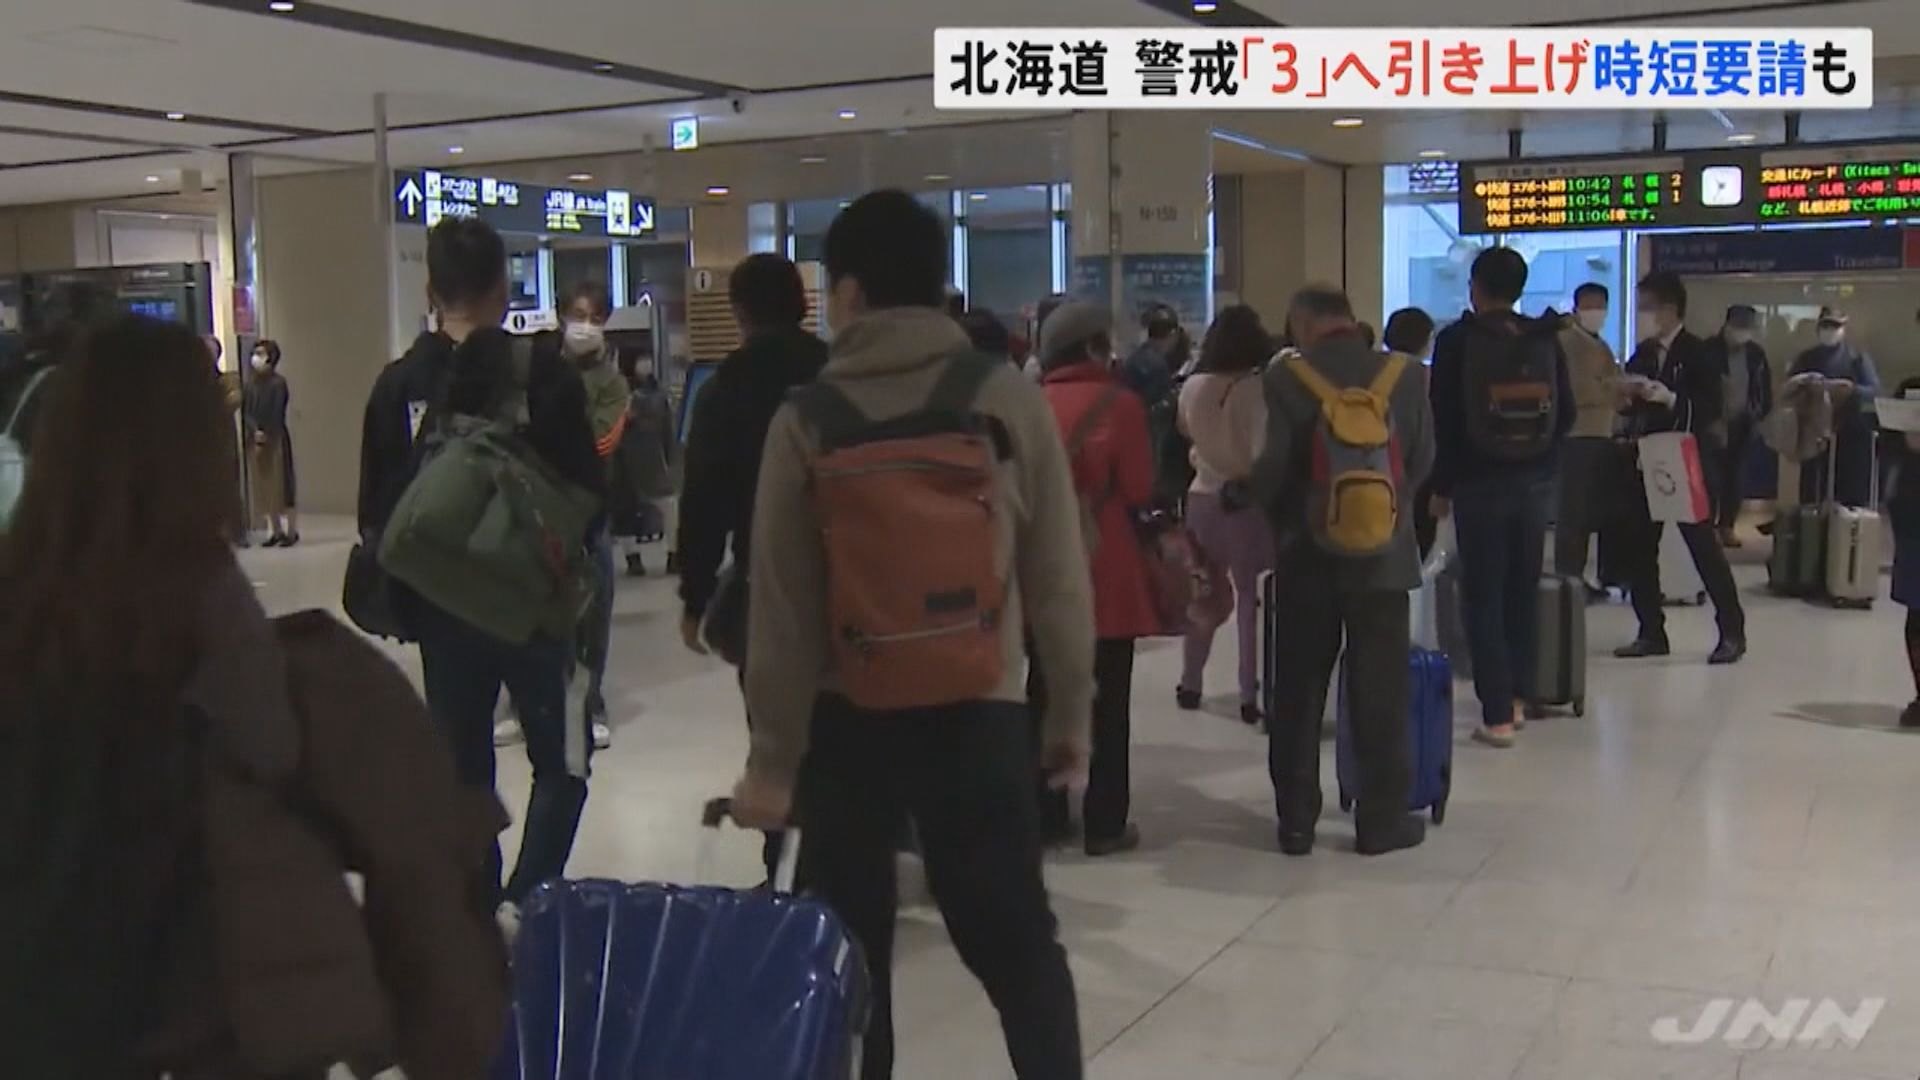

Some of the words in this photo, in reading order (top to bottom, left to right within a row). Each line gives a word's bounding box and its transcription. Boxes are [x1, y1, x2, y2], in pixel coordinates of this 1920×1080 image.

[1568, 176, 1611, 191] 10:42
[1671, 173, 1682, 187] 2
[1568, 192, 1611, 207] 10:54
[1672, 189, 1680, 203] 1
[1568, 208, 1610, 223] 11:06
